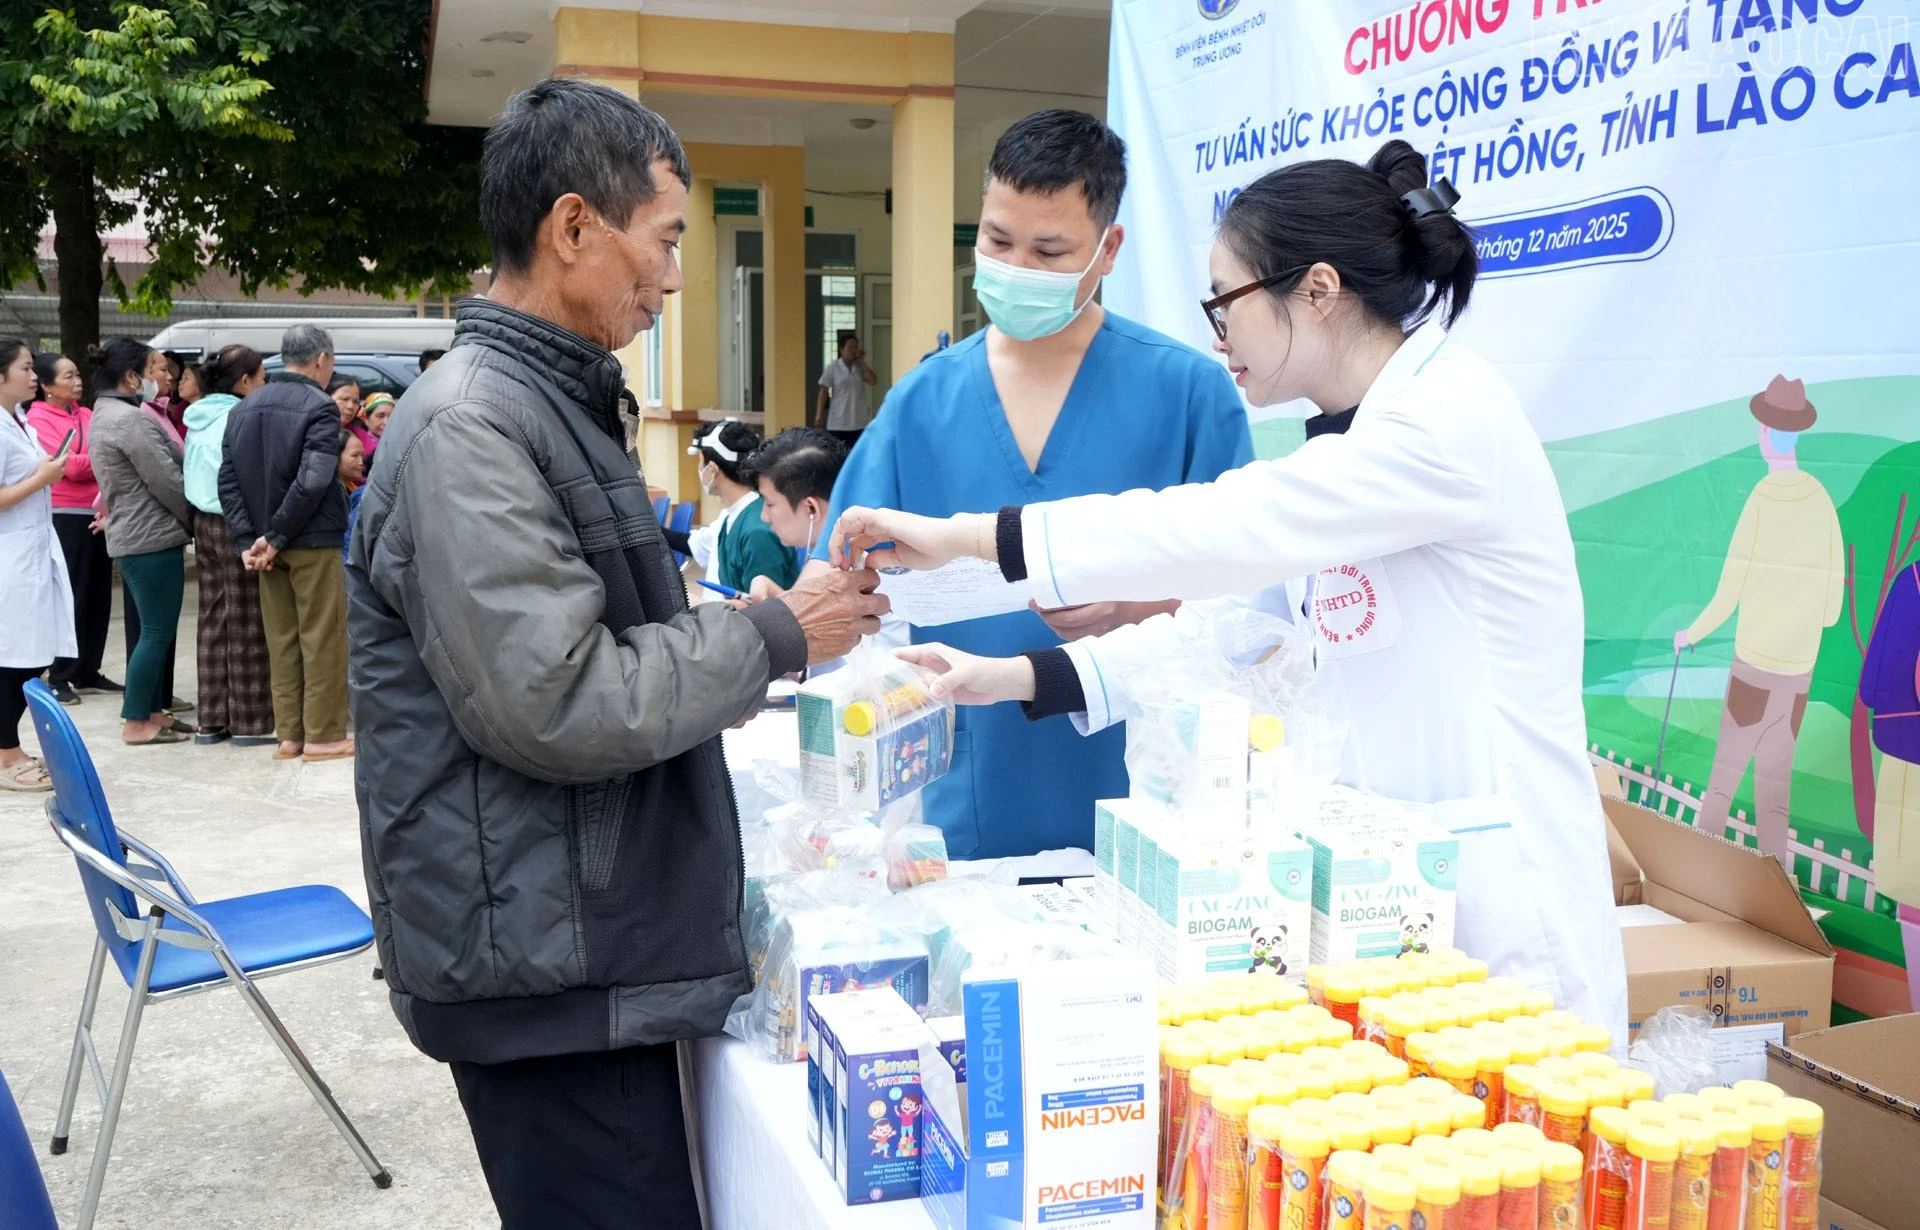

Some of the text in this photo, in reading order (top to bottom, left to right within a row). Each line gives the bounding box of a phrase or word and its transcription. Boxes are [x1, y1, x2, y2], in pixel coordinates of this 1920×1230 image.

[1195, 135, 1221, 174] TƯ
[1223, 117, 1265, 167] VẤN
[1271, 107, 1314, 156] SỨC
[1320, 87, 1405, 145] KHỎE
[1413, 67, 1507, 134] CỘNG
[1520, 30, 1639, 102] ĐỒNG
[1473, 118, 1585, 184] HỒNG,
[1601, 91, 1678, 157] TỈNH
[1697, 61, 1816, 135] LÀO
[1476, 211, 1630, 262] tháng 12 năm 2025
[1358, 574, 1377, 608] TRUNG
[1188, 916, 1253, 935] BIOGAM
[1340, 905, 1402, 923] BIOGAM
[1739, 987, 1758, 1003] T6
[980, 991, 1005, 1120] PACEMIN
[1041, 1102, 1145, 1131] PACEMIN
[1038, 1174, 1145, 1205] PACEMIN
